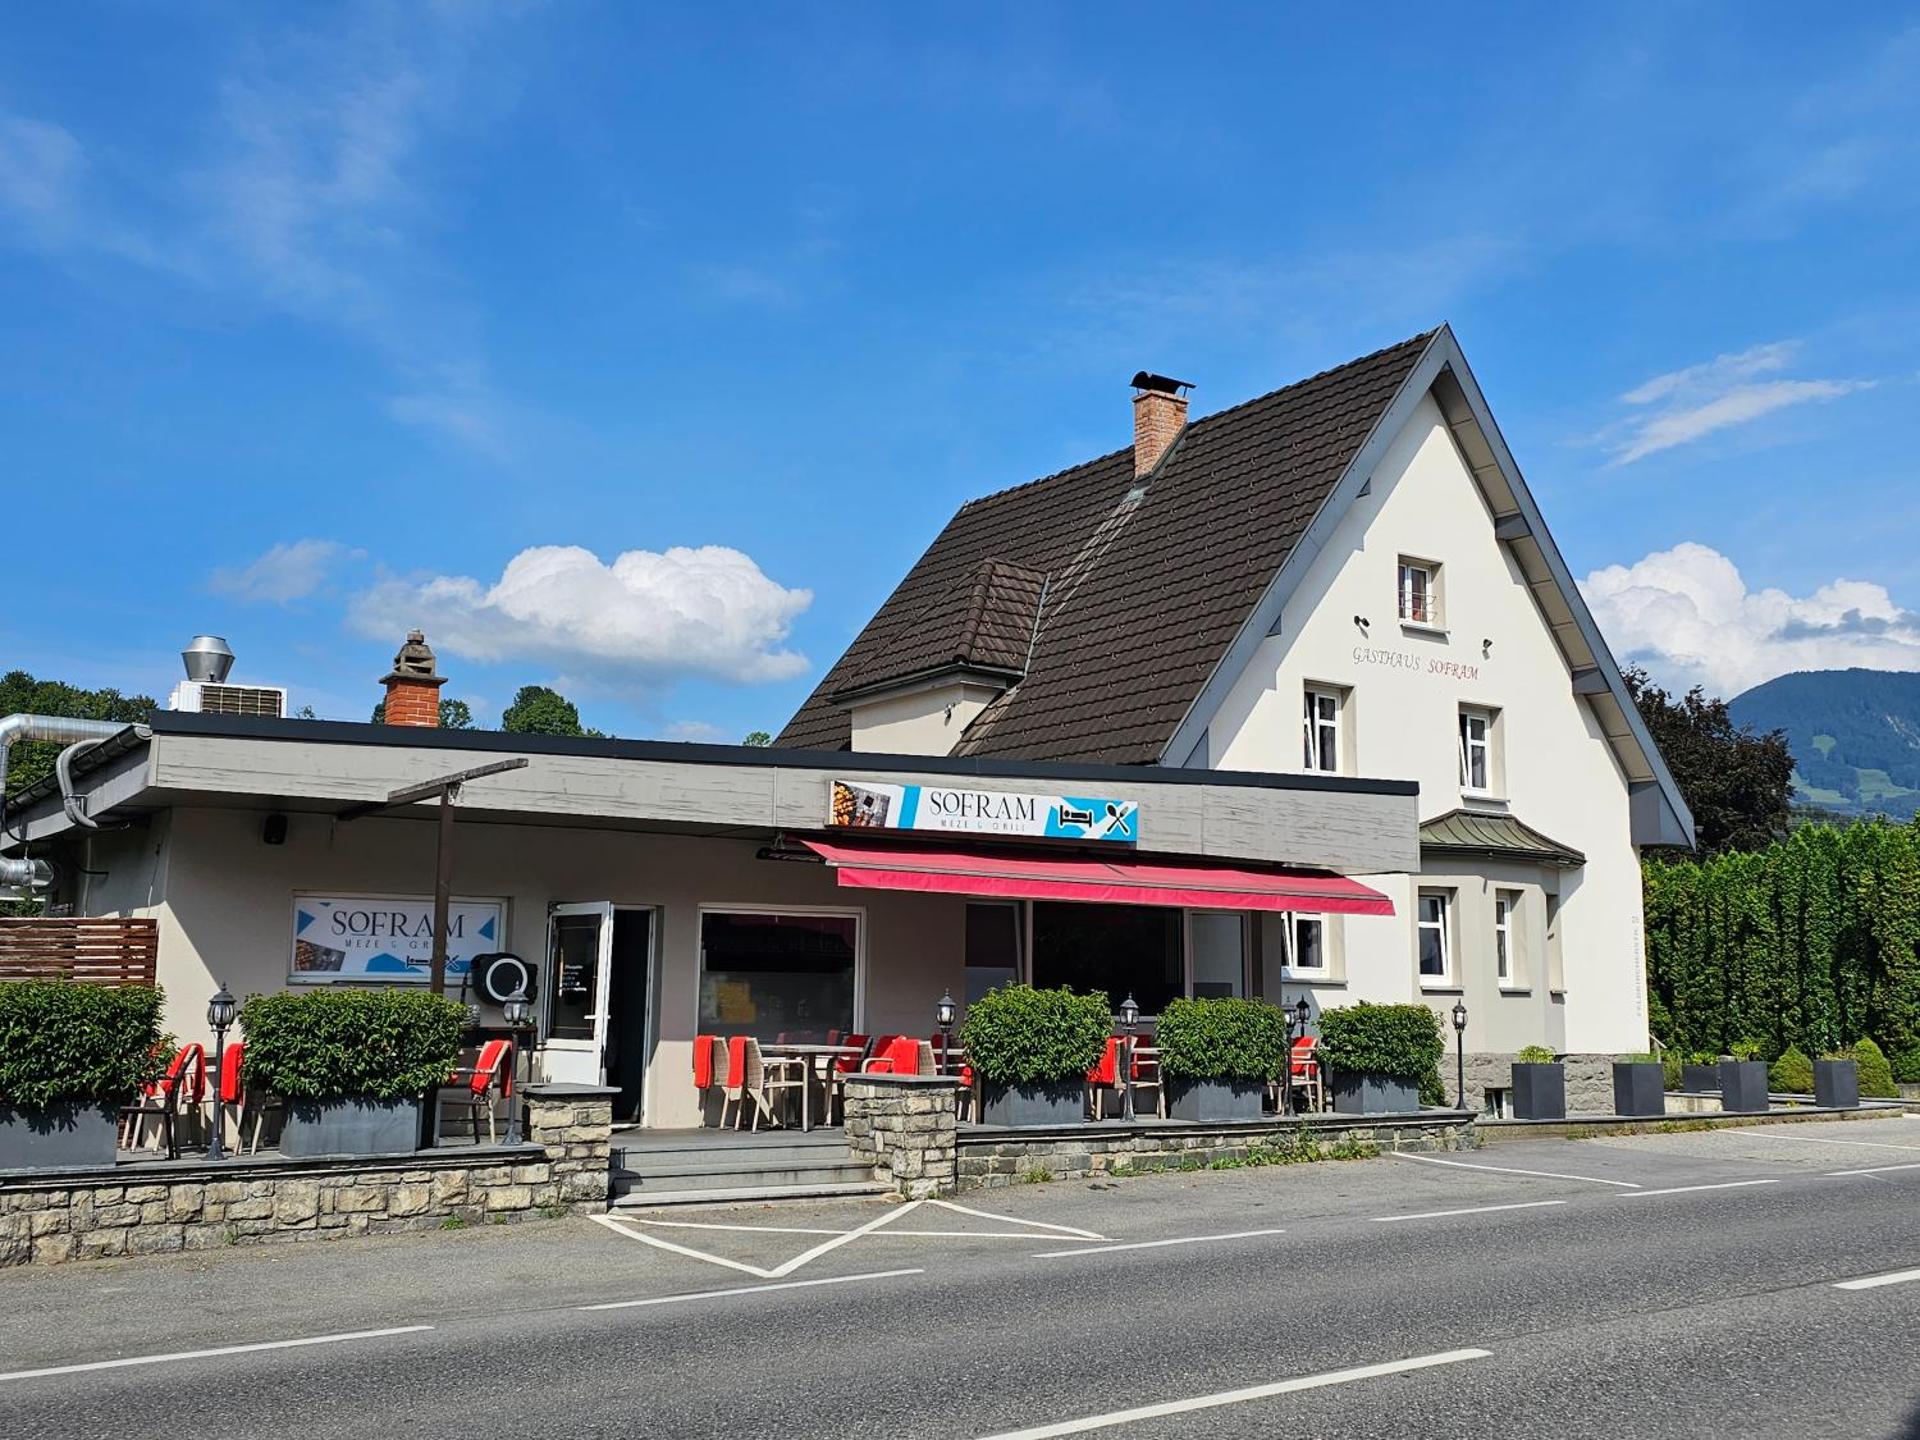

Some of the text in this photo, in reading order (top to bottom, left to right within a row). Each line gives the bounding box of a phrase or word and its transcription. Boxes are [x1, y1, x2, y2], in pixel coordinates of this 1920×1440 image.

[1353, 646, 1479, 681] GASTHAUS SOFRAM
[930, 790, 1035, 821] SOFRAM
[941, 819, 968, 829] MEZE
[331, 910, 465, 938] SOFRAM
[345, 939, 379, 949] MEZE
